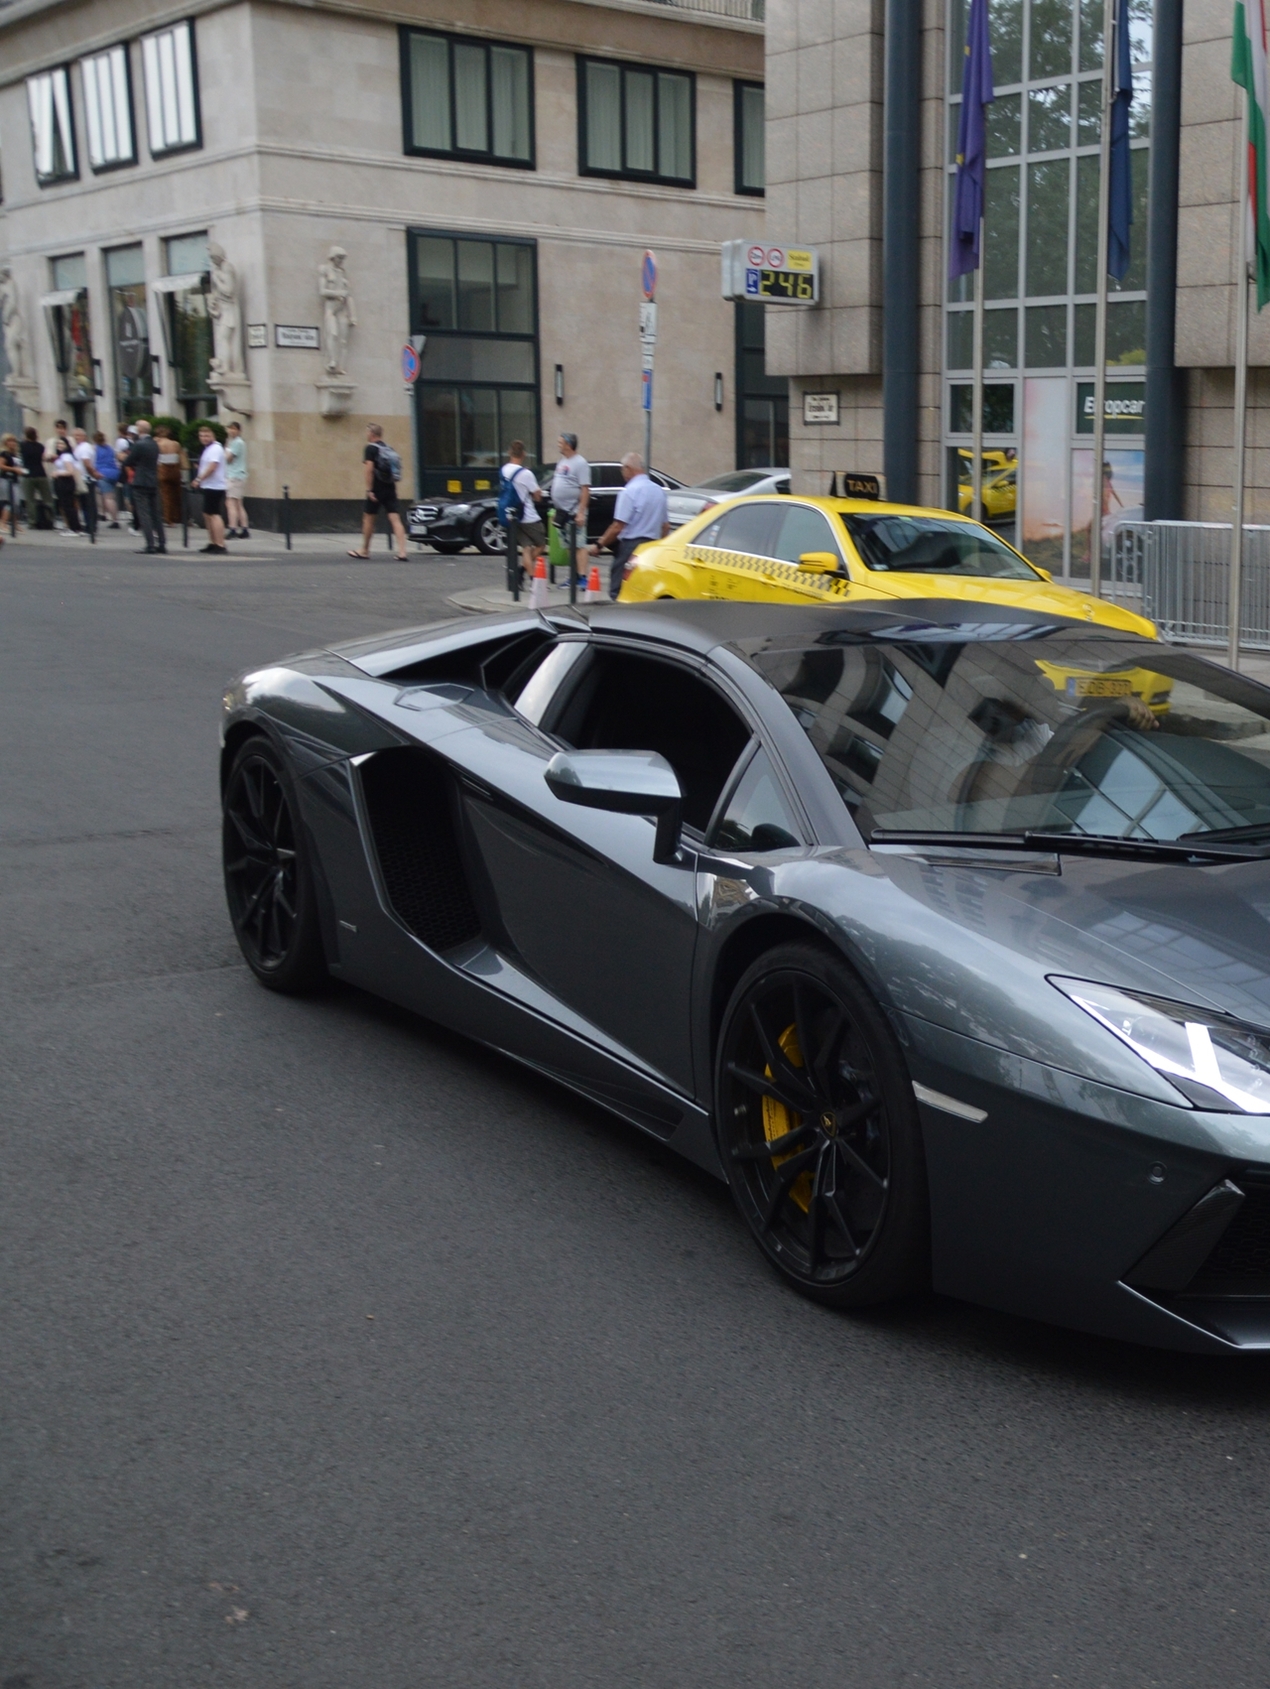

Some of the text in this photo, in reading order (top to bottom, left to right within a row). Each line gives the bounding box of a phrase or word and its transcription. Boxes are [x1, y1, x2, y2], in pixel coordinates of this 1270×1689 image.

[760, 270, 813, 299] 246
[1084, 396, 1146, 419] Eopcar
[847, 479, 878, 494] TAXI
